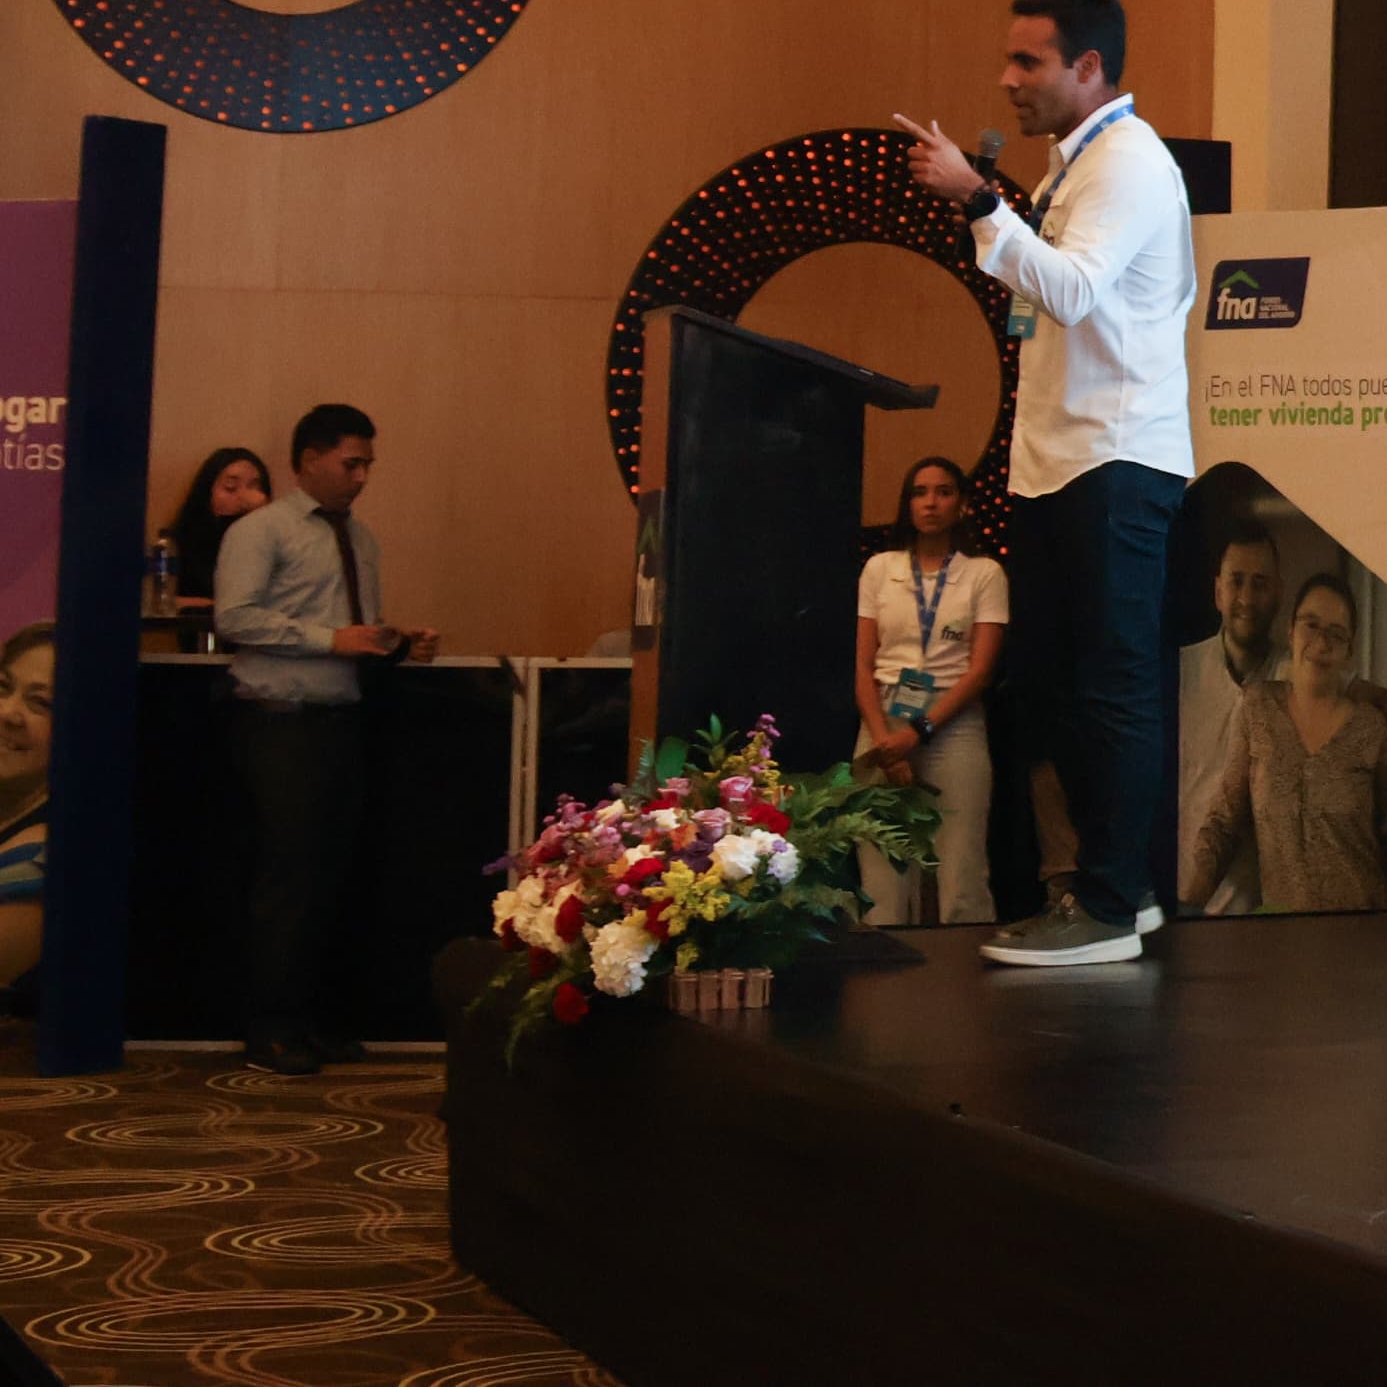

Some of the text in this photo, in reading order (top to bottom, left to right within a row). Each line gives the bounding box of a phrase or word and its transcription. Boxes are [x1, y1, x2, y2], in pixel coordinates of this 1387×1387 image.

[1216, 287, 1257, 320] fna
[1204, 375, 1232, 402] ¡En
[1238, 375, 1253, 397] el
[1260, 374, 1296, 397] FNA
[1303, 374, 1352, 396] todos
[0, 396, 67, 433] gar
[1209, 405, 1262, 427] tener
[1269, 401, 1354, 426] vivienda
